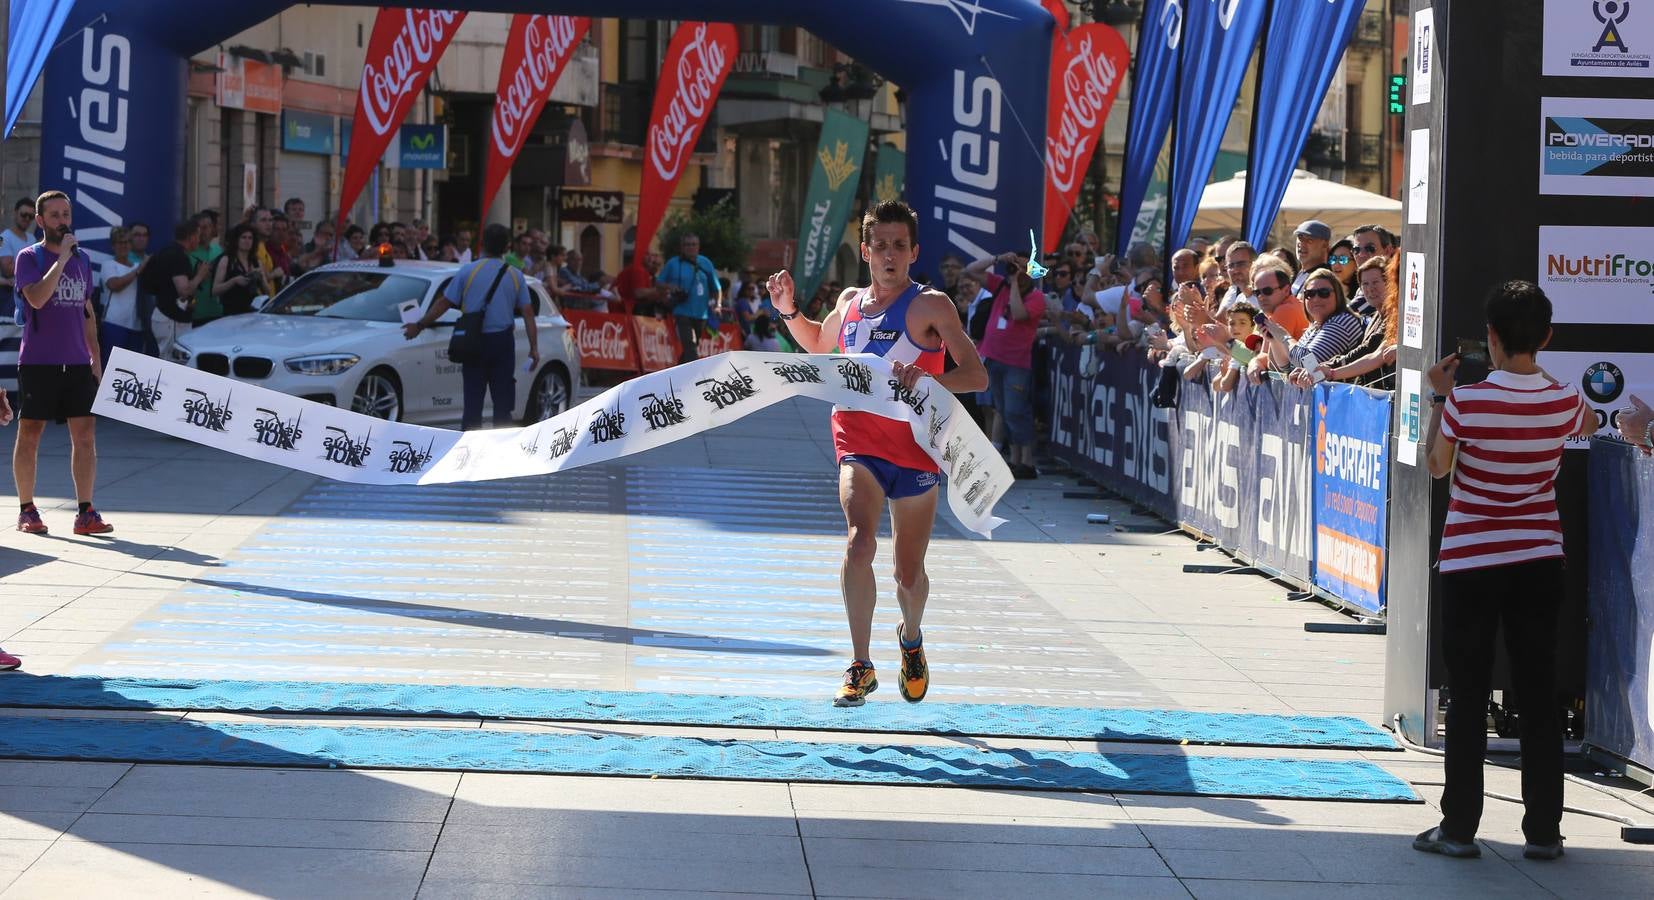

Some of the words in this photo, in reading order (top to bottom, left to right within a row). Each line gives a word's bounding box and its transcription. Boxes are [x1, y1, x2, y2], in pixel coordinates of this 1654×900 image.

[361, 8, 459, 136] Coca-Co
[652, 21, 725, 180] Coca-Cola
[1046, 31, 1117, 192] Coca-Cola
[934, 69, 1001, 274] vilés
[1549, 150, 1583, 160] bebida
[1585, 154, 1607, 163] para
[1609, 152, 1654, 164] deportist
[804, 200, 832, 277] RURAL
[1548, 254, 1654, 277] NutriFro
[577, 319, 629, 360] Coca-Cola
[873, 331, 897, 340] Toscaf
[1587, 363, 1621, 377] BMW
